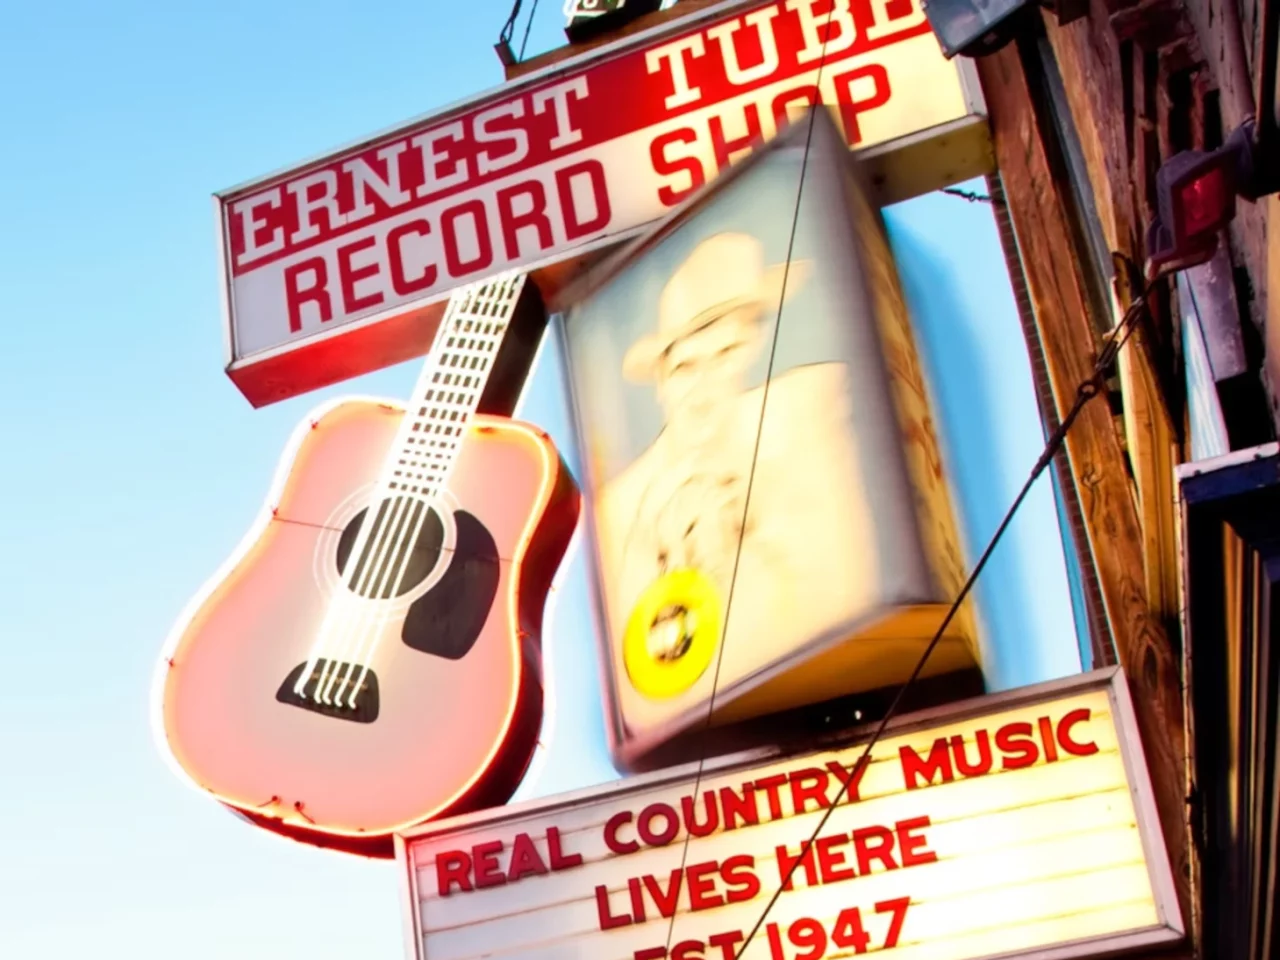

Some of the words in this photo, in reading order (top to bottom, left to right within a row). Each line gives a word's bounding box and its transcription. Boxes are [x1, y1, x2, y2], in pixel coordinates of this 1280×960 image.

[233, 75, 590, 267] ERNEST
[283, 158, 613, 334] RECORD
[436, 826, 582, 897] REAL
[603, 754, 873, 857] COUNTRY
[898, 708, 1100, 792] MUSIC
[594, 855, 762, 932] LIVES
[776, 815, 939, 892] HERE
